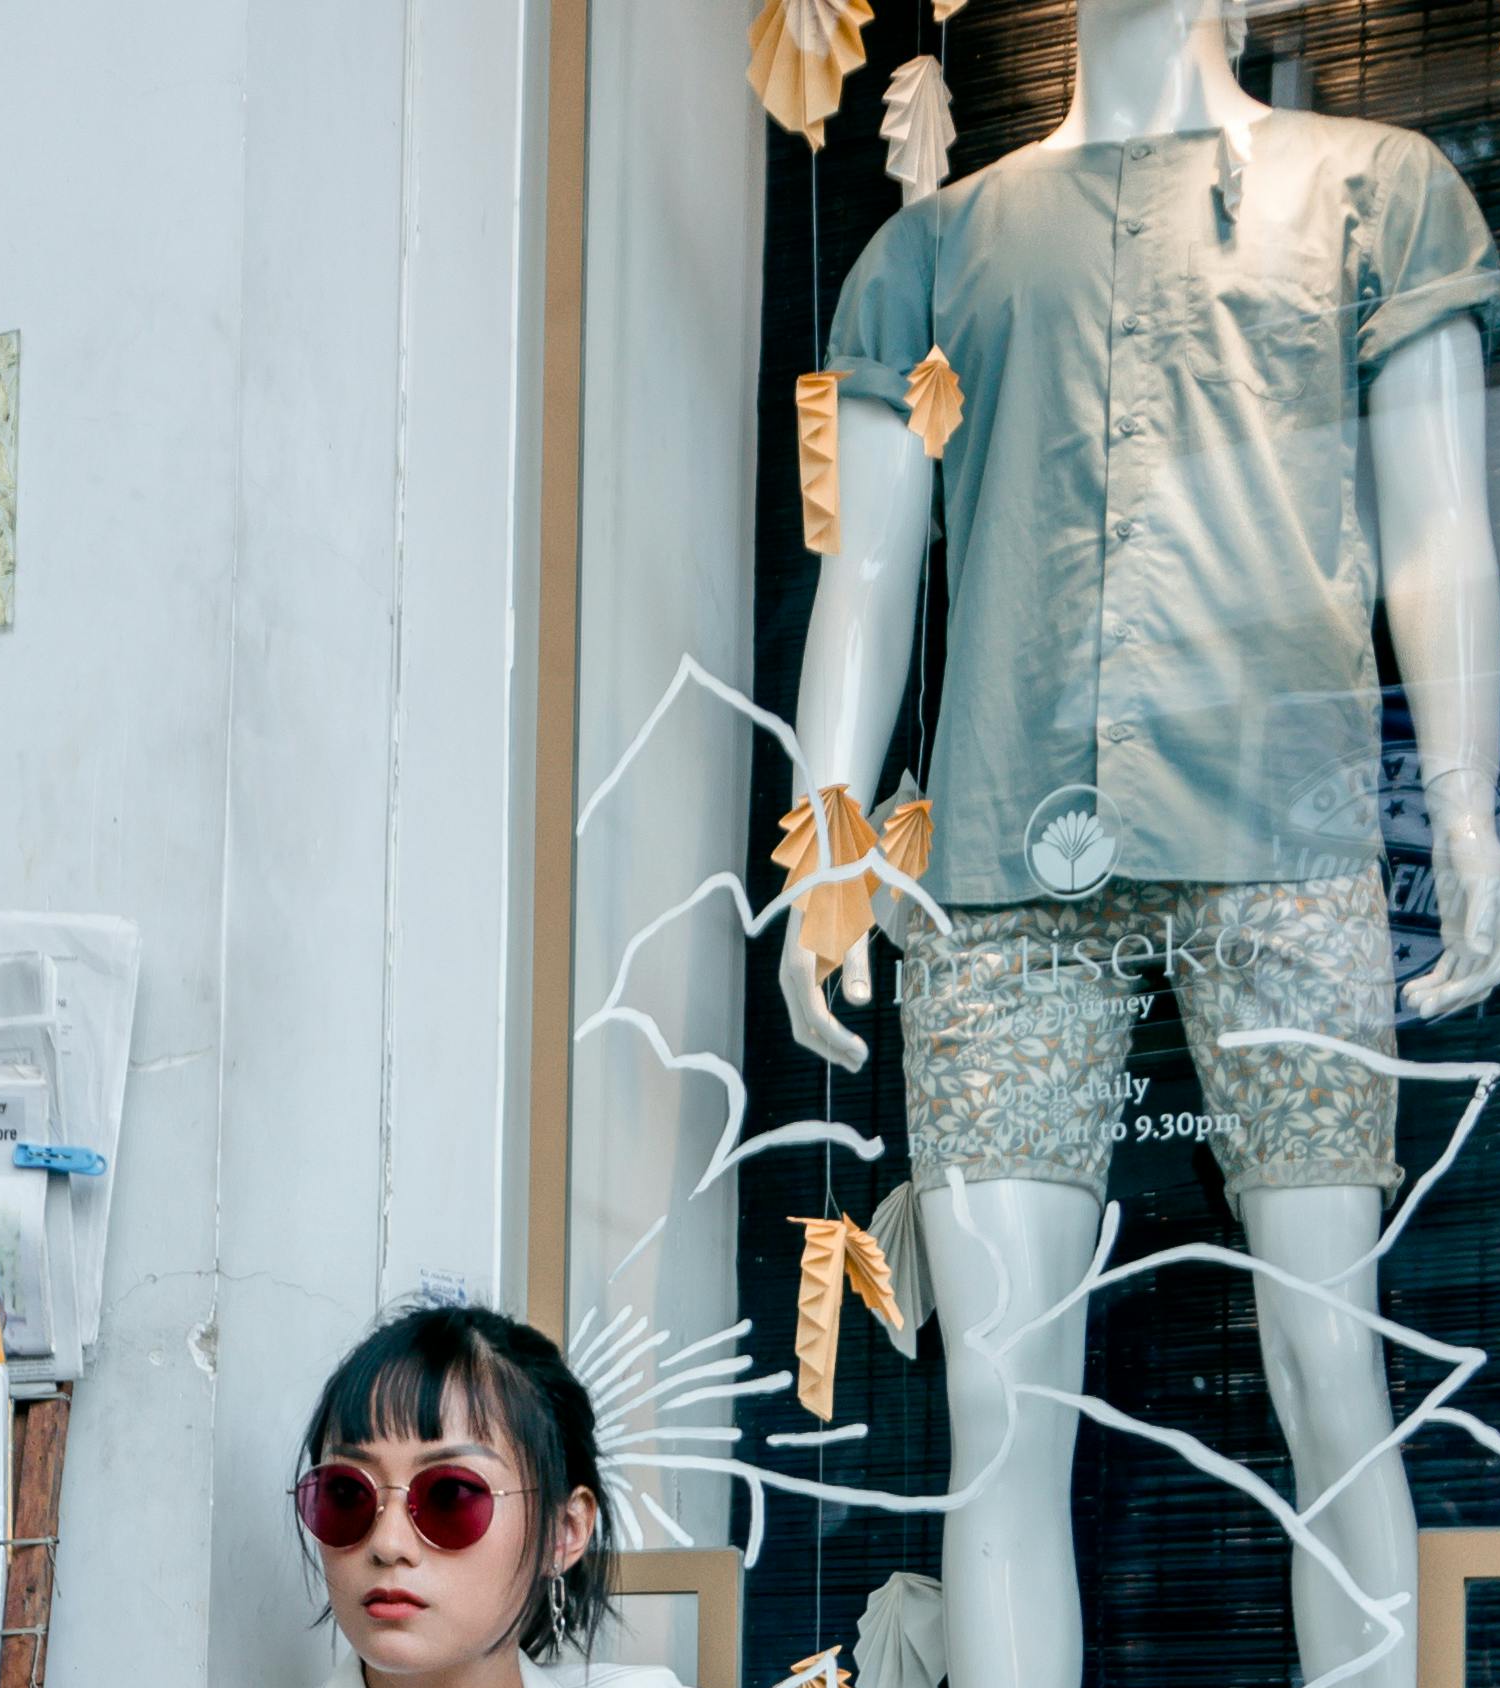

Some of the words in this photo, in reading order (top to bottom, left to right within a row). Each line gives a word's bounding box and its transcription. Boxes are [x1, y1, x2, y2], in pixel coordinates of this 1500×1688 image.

[1079, 1071, 1151, 1105] daily
[1101, 1115, 1128, 1142] to
[1134, 1110, 1242, 1145] 9.30pm
